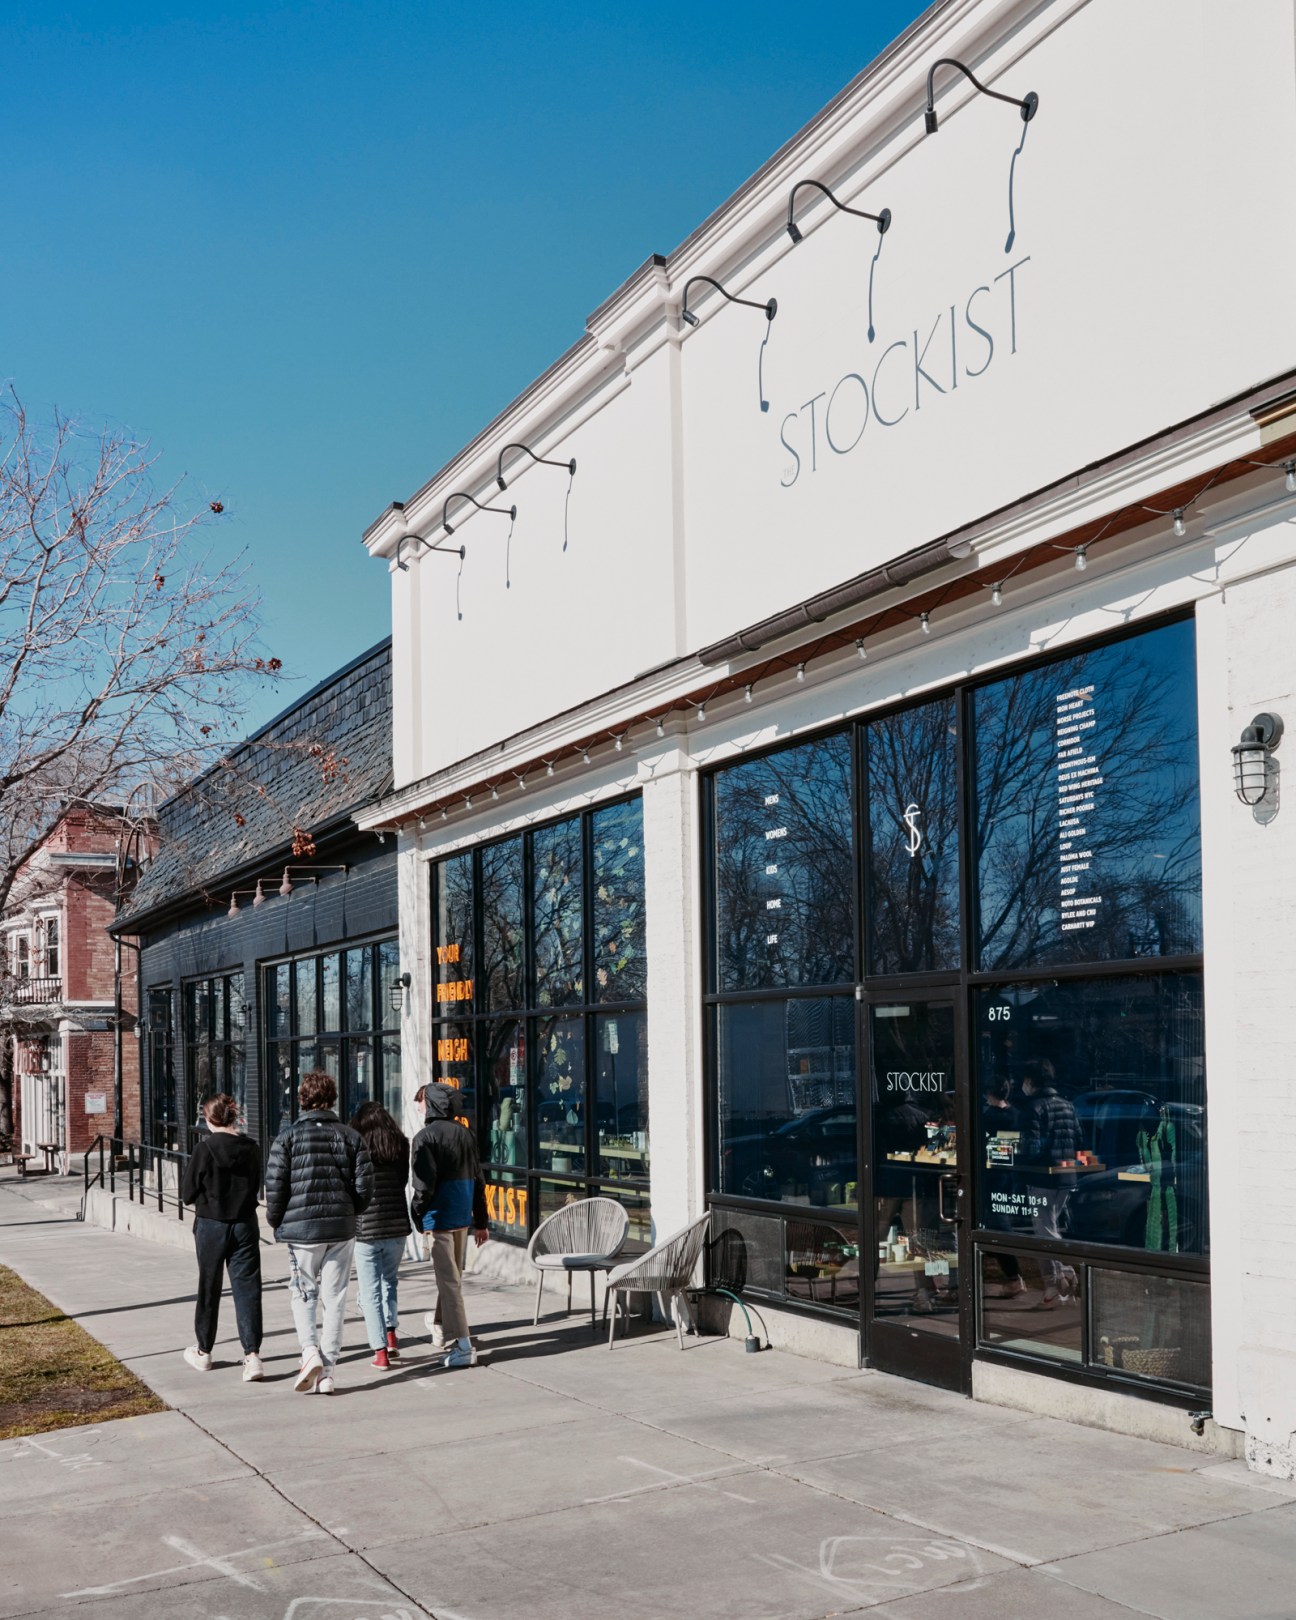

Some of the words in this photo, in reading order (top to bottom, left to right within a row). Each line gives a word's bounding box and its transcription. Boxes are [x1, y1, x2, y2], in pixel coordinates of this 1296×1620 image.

[781, 256, 1030, 487] STOCKIST
[1069, 700, 1083, 709] HEART
[1073, 709, 1095, 720] PROJECTS
[1079, 720, 1096, 730] CHAMP
[1067, 748, 1082, 756] AFIELD
[1078, 767, 1099, 777] MACHINA
[1081, 778, 1103, 787] HERITAGE
[765, 794, 779, 806] MENS
[1059, 794, 1083, 804] SATURDAYS
[765, 827, 787, 840] WOMENS
[1068, 828, 1085, 837] GOLDEN
[766, 864, 778, 874] KIDS
[1072, 863, 1089, 871] FEMALE
[767, 899, 781, 909] HOME
[1062, 922, 1084, 930] CARHARTT
[767, 934, 778, 944] LIFE
[436, 944, 460, 965] YOUR
[436, 979, 473, 1002] FRIENDLY
[988, 1006, 1011, 1021] 875
[437, 1038, 468, 1062] NEIGH
[886, 1072, 945, 1092] STOCKIST
[991, 1192, 1025, 1204] MON-SAT
[1028, 1196, 1036, 1205] 10
[1042, 1197, 1047, 1206] 8
[992, 1203, 1019, 1214] SUNDAY
[1022, 1207, 1027, 1215] 11
[1033, 1207, 1038, 1217] 5
